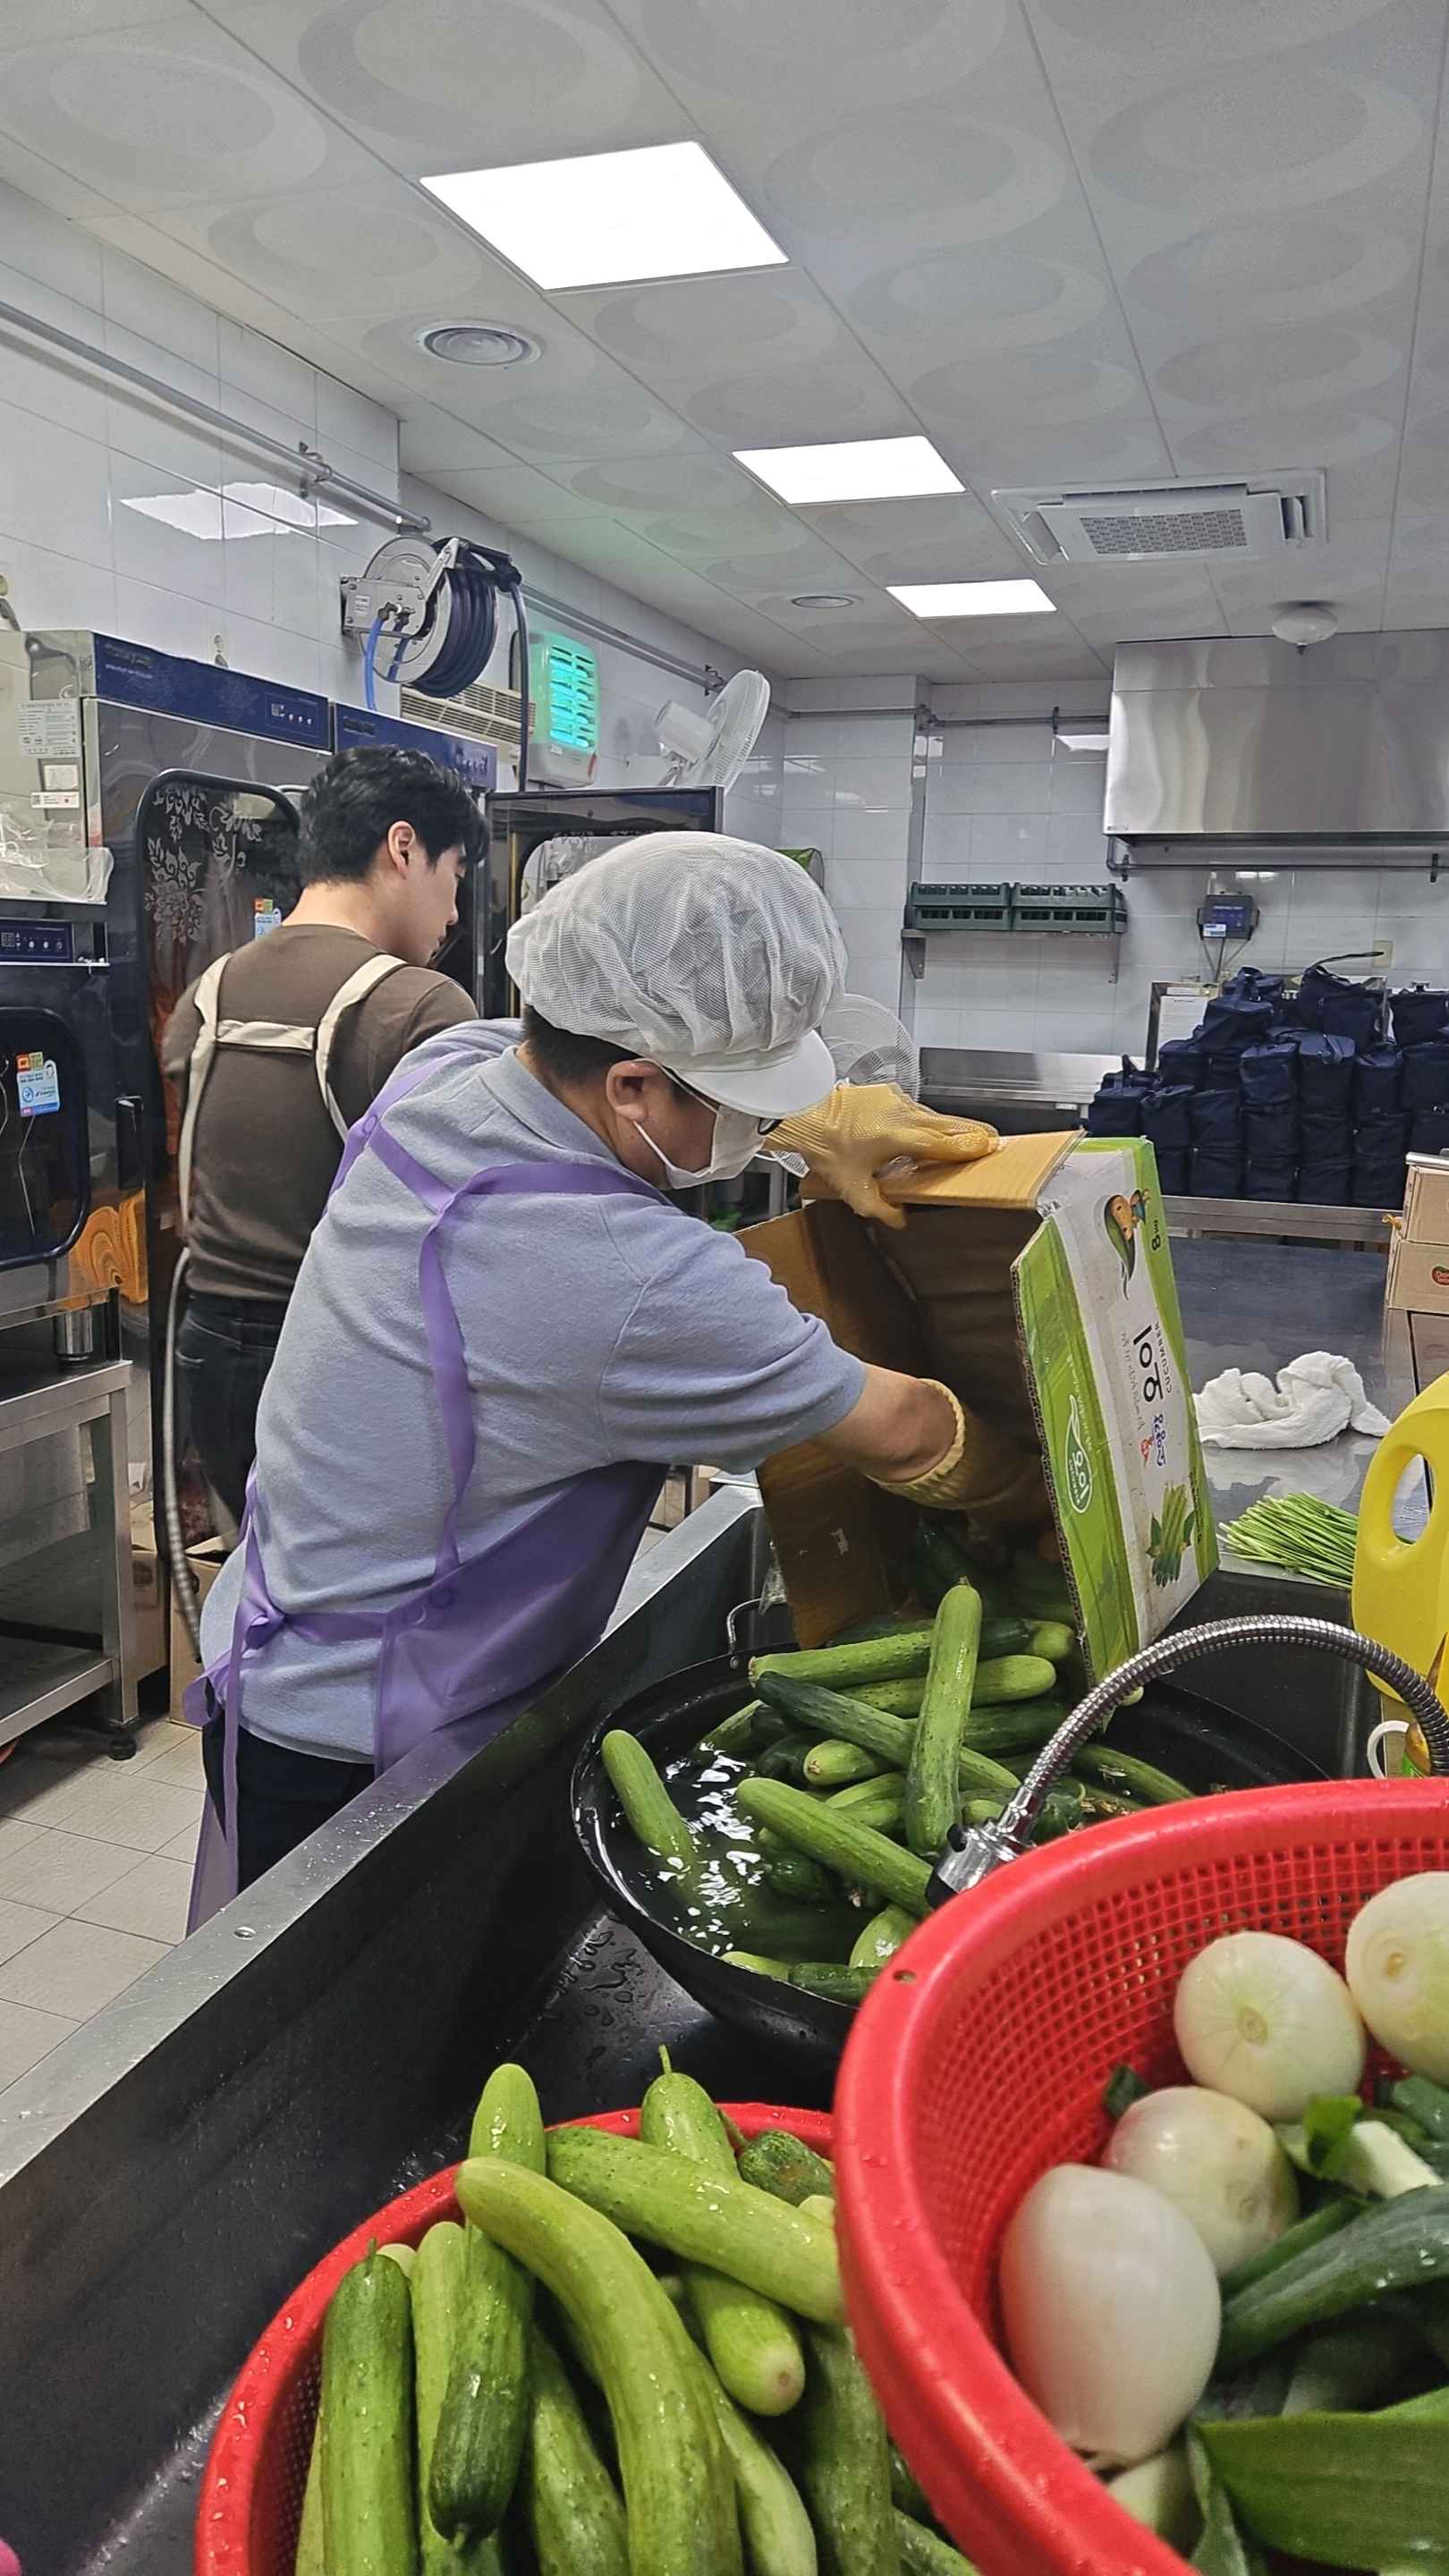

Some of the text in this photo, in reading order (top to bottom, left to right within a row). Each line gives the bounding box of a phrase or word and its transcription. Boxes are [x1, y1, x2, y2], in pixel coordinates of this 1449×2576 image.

[1133, 1325, 1163, 1402] 오이
[1155, 1322, 1172, 1394] CUCUMBER
[1072, 1451, 1089, 1500] 오이
